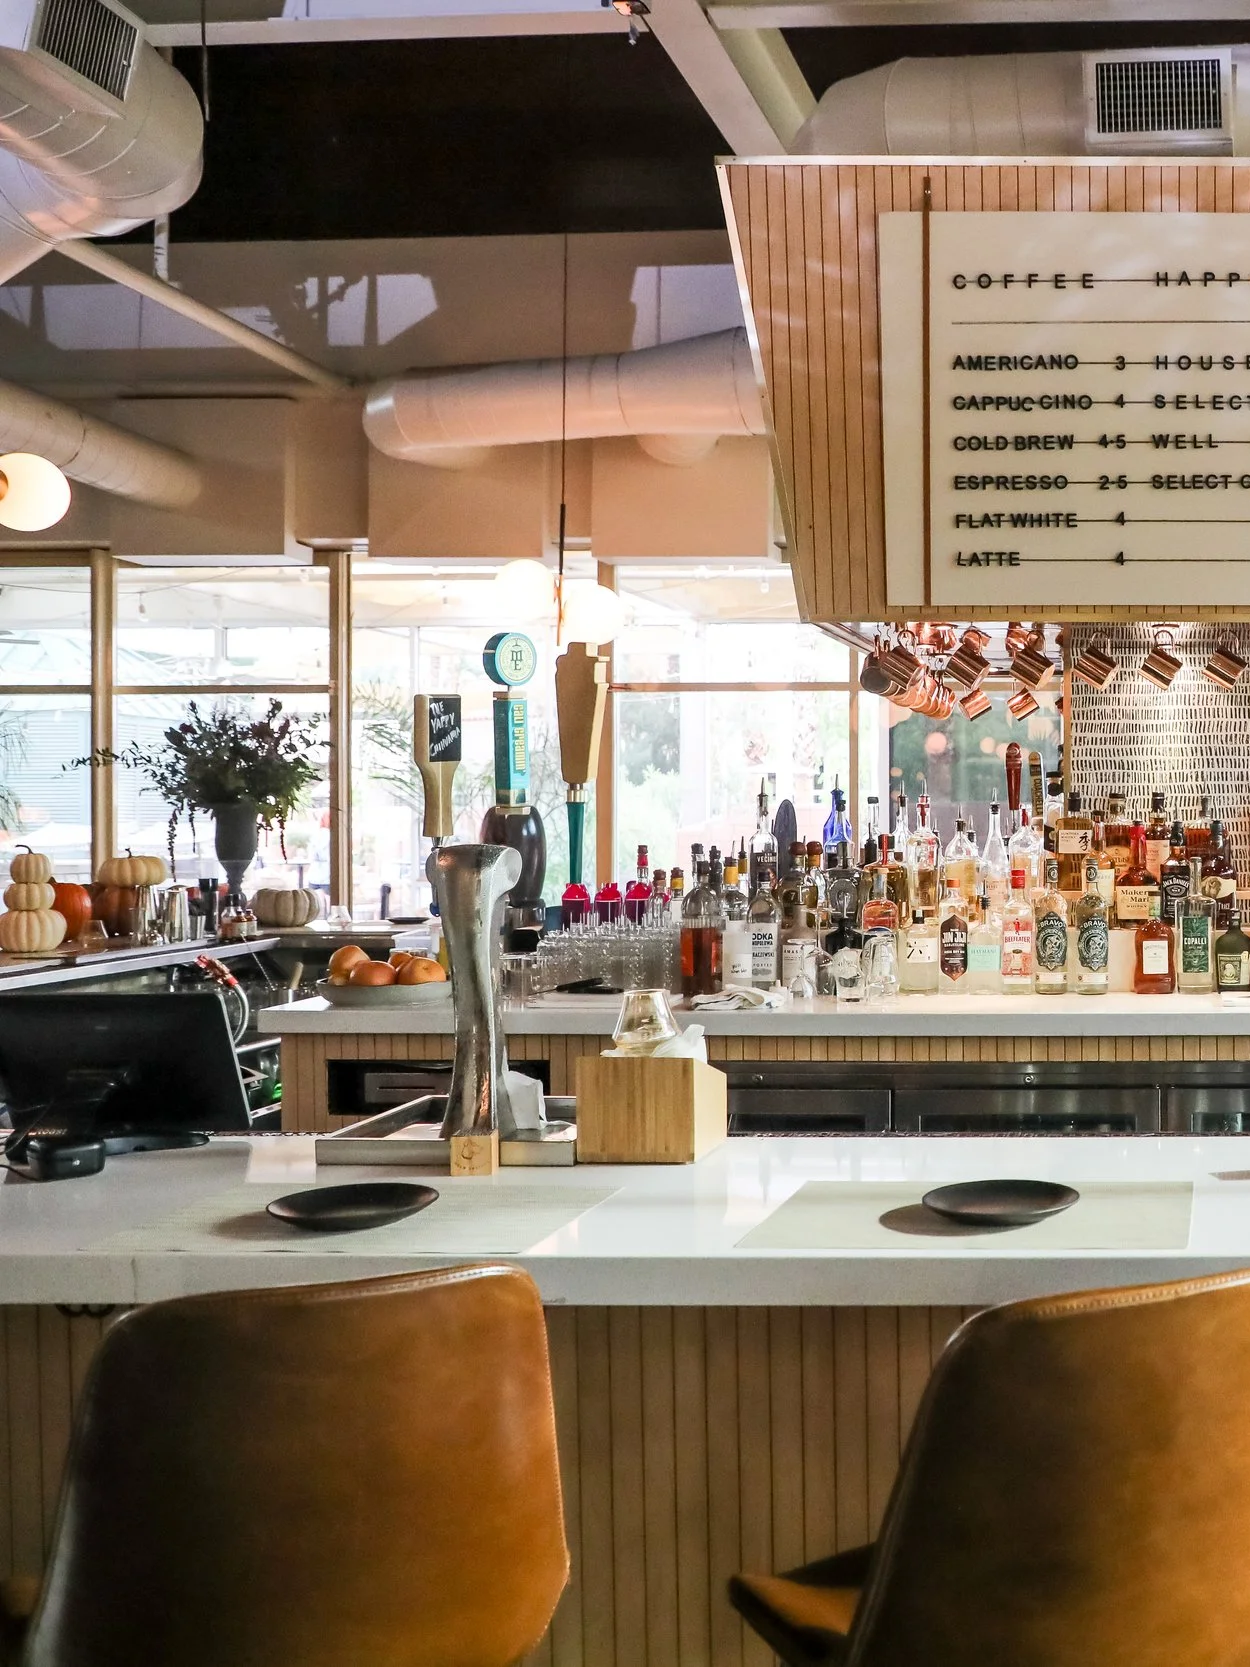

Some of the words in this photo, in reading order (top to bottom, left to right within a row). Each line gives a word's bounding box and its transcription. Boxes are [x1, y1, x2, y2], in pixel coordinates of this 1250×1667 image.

[952, 273, 1094, 290] COFFEE
[952, 354, 1079, 371] AMERICANO
[1115, 355, 1126, 371] 3
[1114, 393, 1125, 409] 4
[953, 435, 1009, 452] COLD
[1013, 434, 1075, 452] BREW
[1151, 433, 1218, 450] WELL
[953, 474, 1068, 491] ESPRESSO
[1151, 474, 1233, 490] SELECT
[954, 513, 1005, 529] FLAT
[1009, 512, 1078, 529] WHITE
[1114, 511, 1126, 526] 4
[955, 551, 1020, 567] LATTE
[1114, 551, 1126, 566] 4
[1040, 919, 1064, 929] BRAVO
[1083, 919, 1106, 929] BRAVO
[752, 932, 774, 941] ODKA
[1004, 935, 1031, 943] BEEFEATER
